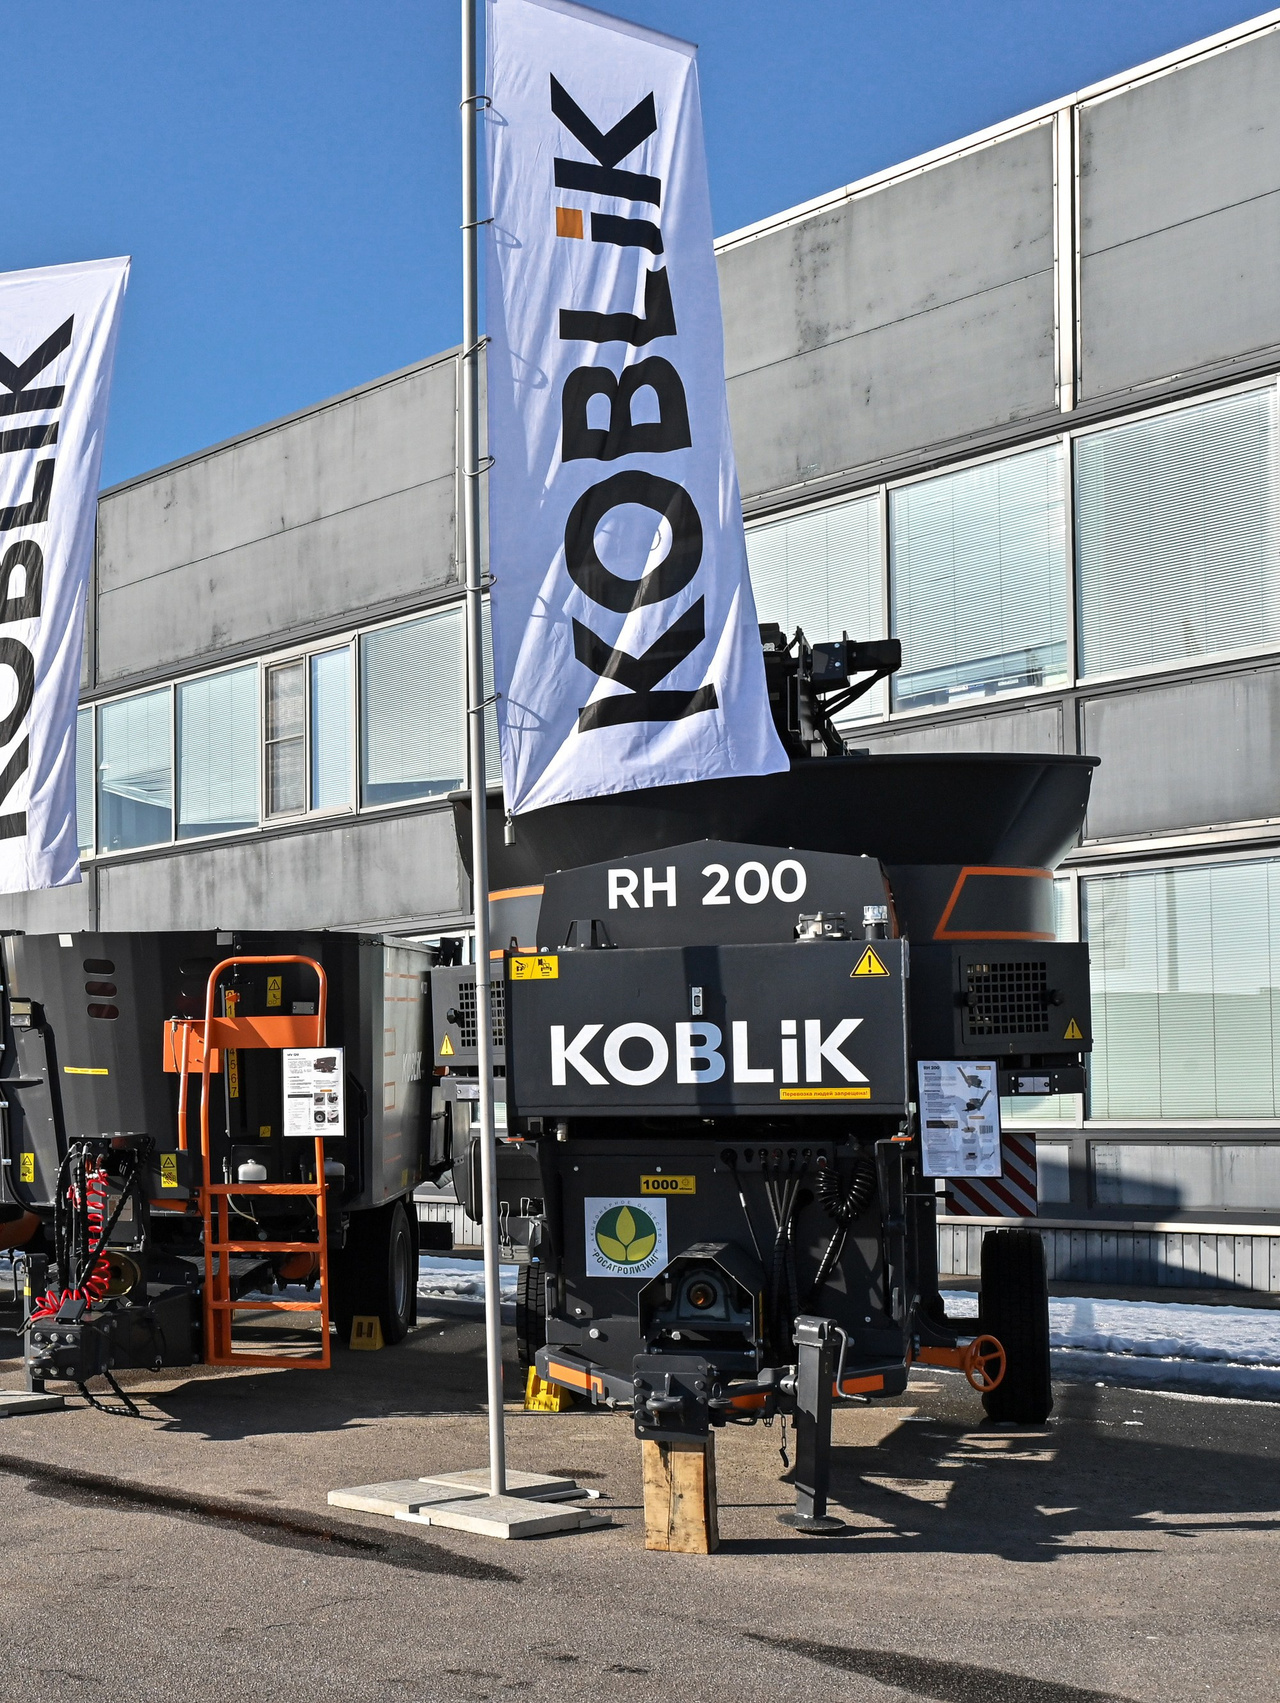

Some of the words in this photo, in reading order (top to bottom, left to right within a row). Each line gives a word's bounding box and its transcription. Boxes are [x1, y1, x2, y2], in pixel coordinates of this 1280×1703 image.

[607, 866, 677, 910] RH
[702, 859, 807, 905] 200
[643, 1179, 678, 1190] 1000
